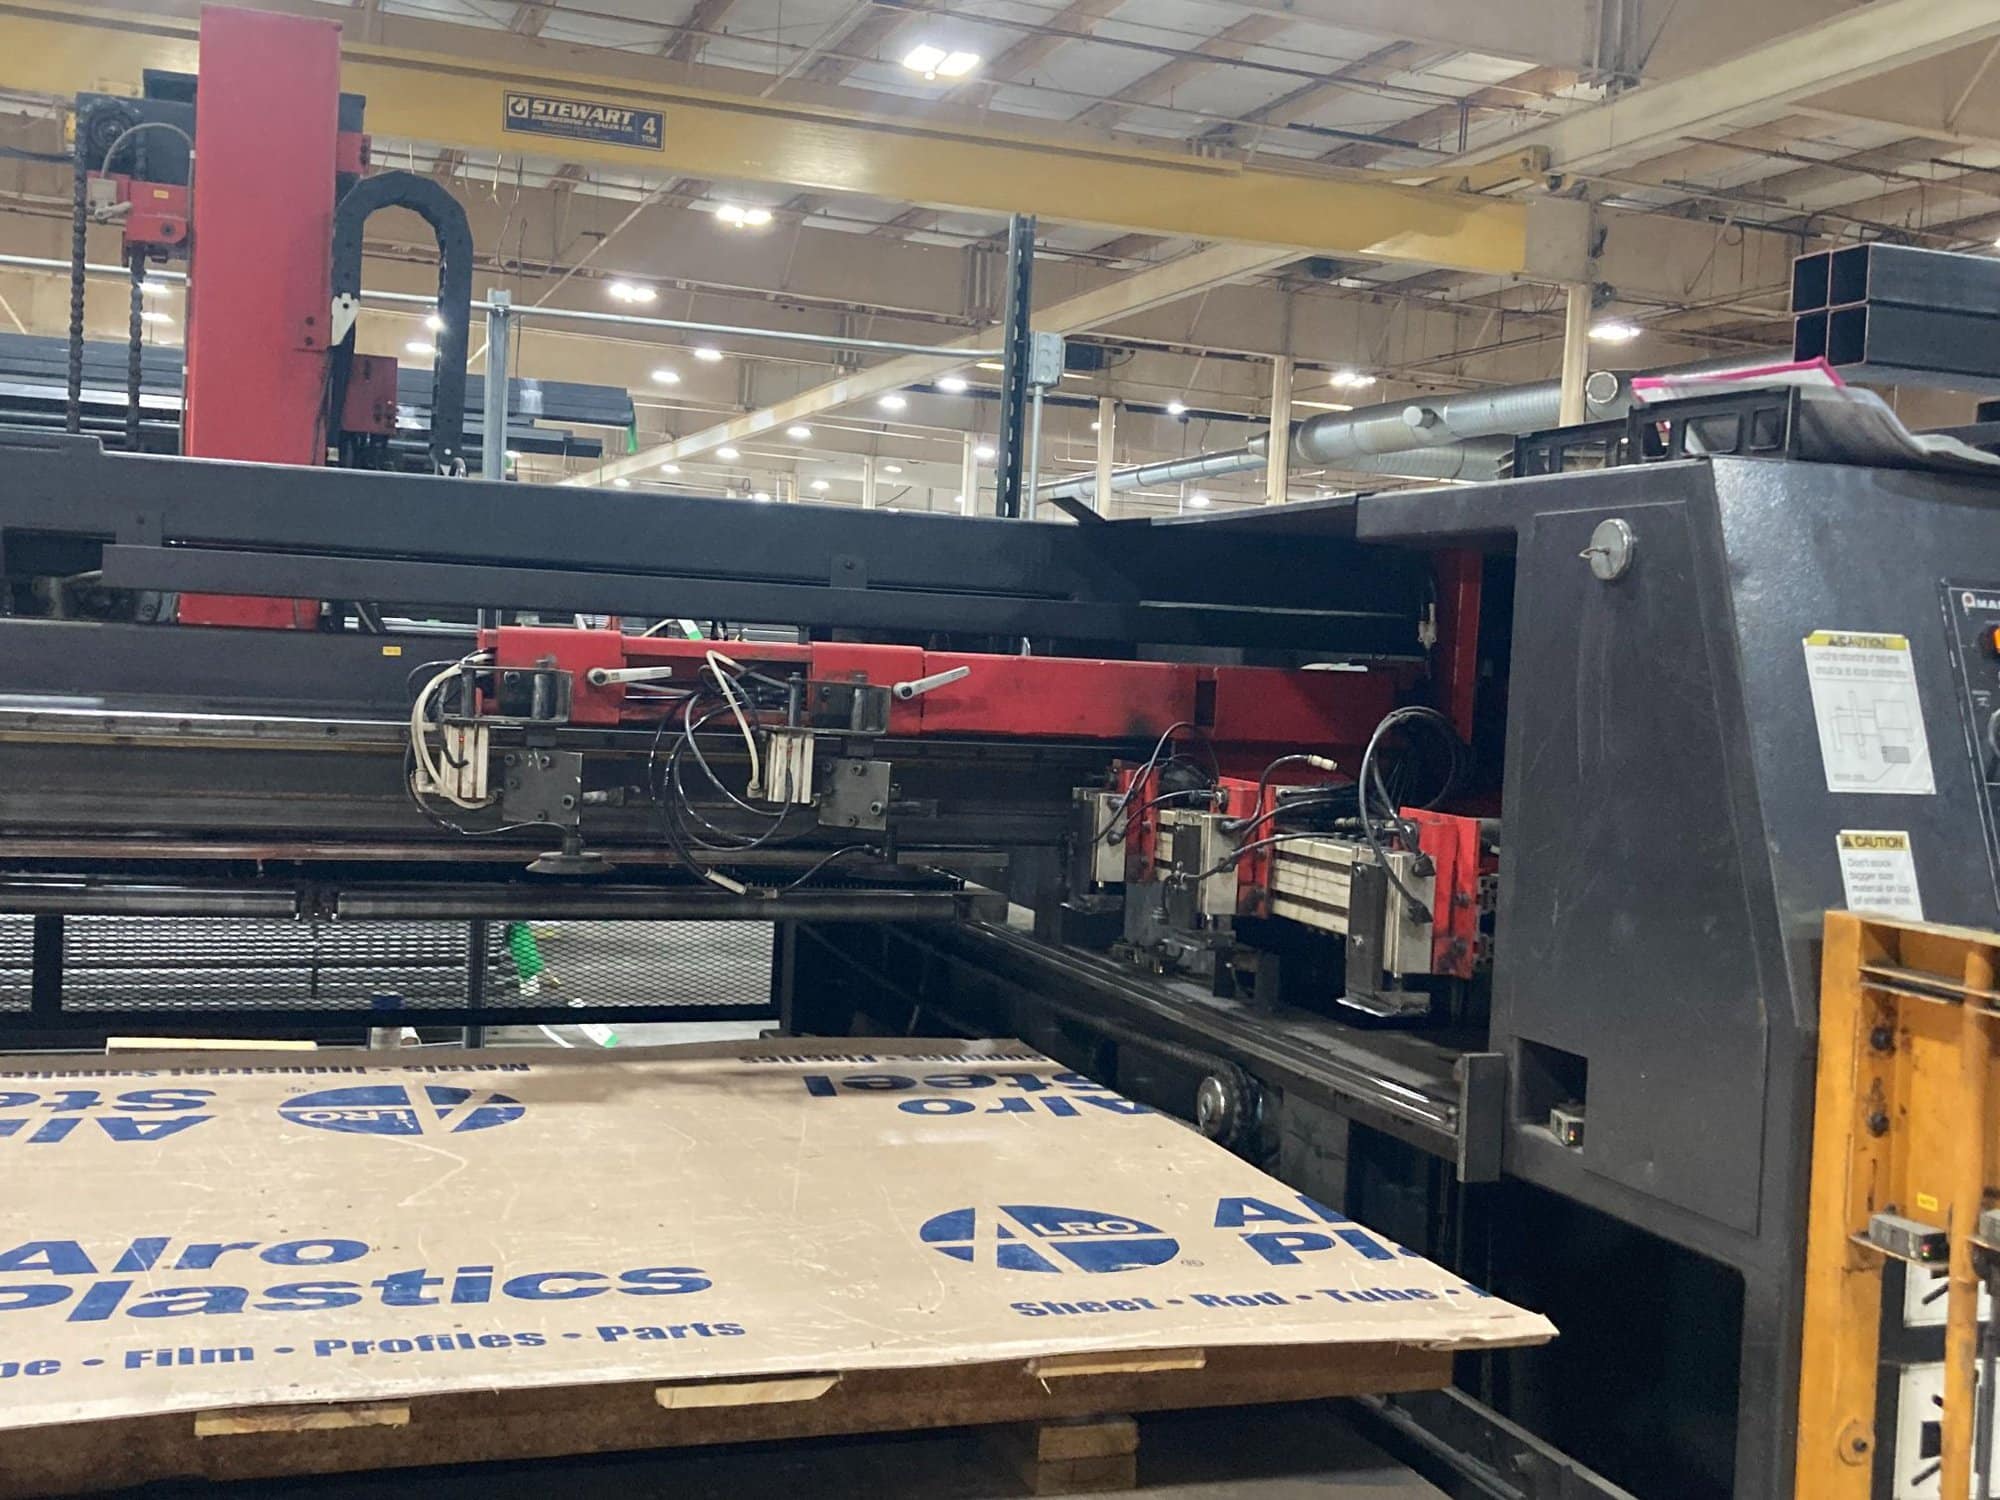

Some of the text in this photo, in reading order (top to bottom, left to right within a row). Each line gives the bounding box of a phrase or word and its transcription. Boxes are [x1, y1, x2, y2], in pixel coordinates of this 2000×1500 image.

[532, 100, 634, 125] STEWART
[642, 117, 657, 134] 4
[642, 135, 657, 145] TON
[1838, 635, 1886, 648] CAUTION
[1855, 836, 1904, 849] CAUTION
[803, 1072, 1106, 1096] Steel
[898, 1095, 1155, 1116] Alro
[0, 1237, 369, 1275] Alro
[1238, 1229, 1418, 1265] Pl
[0, 1266, 712, 1322] Plastics
[1010, 1287, 1438, 1317] Sheet Rod Tube
[125, 1347, 254, 1369] Film
[314, 1332, 547, 1357] Profiles
[596, 1322, 746, 1343] Parts
